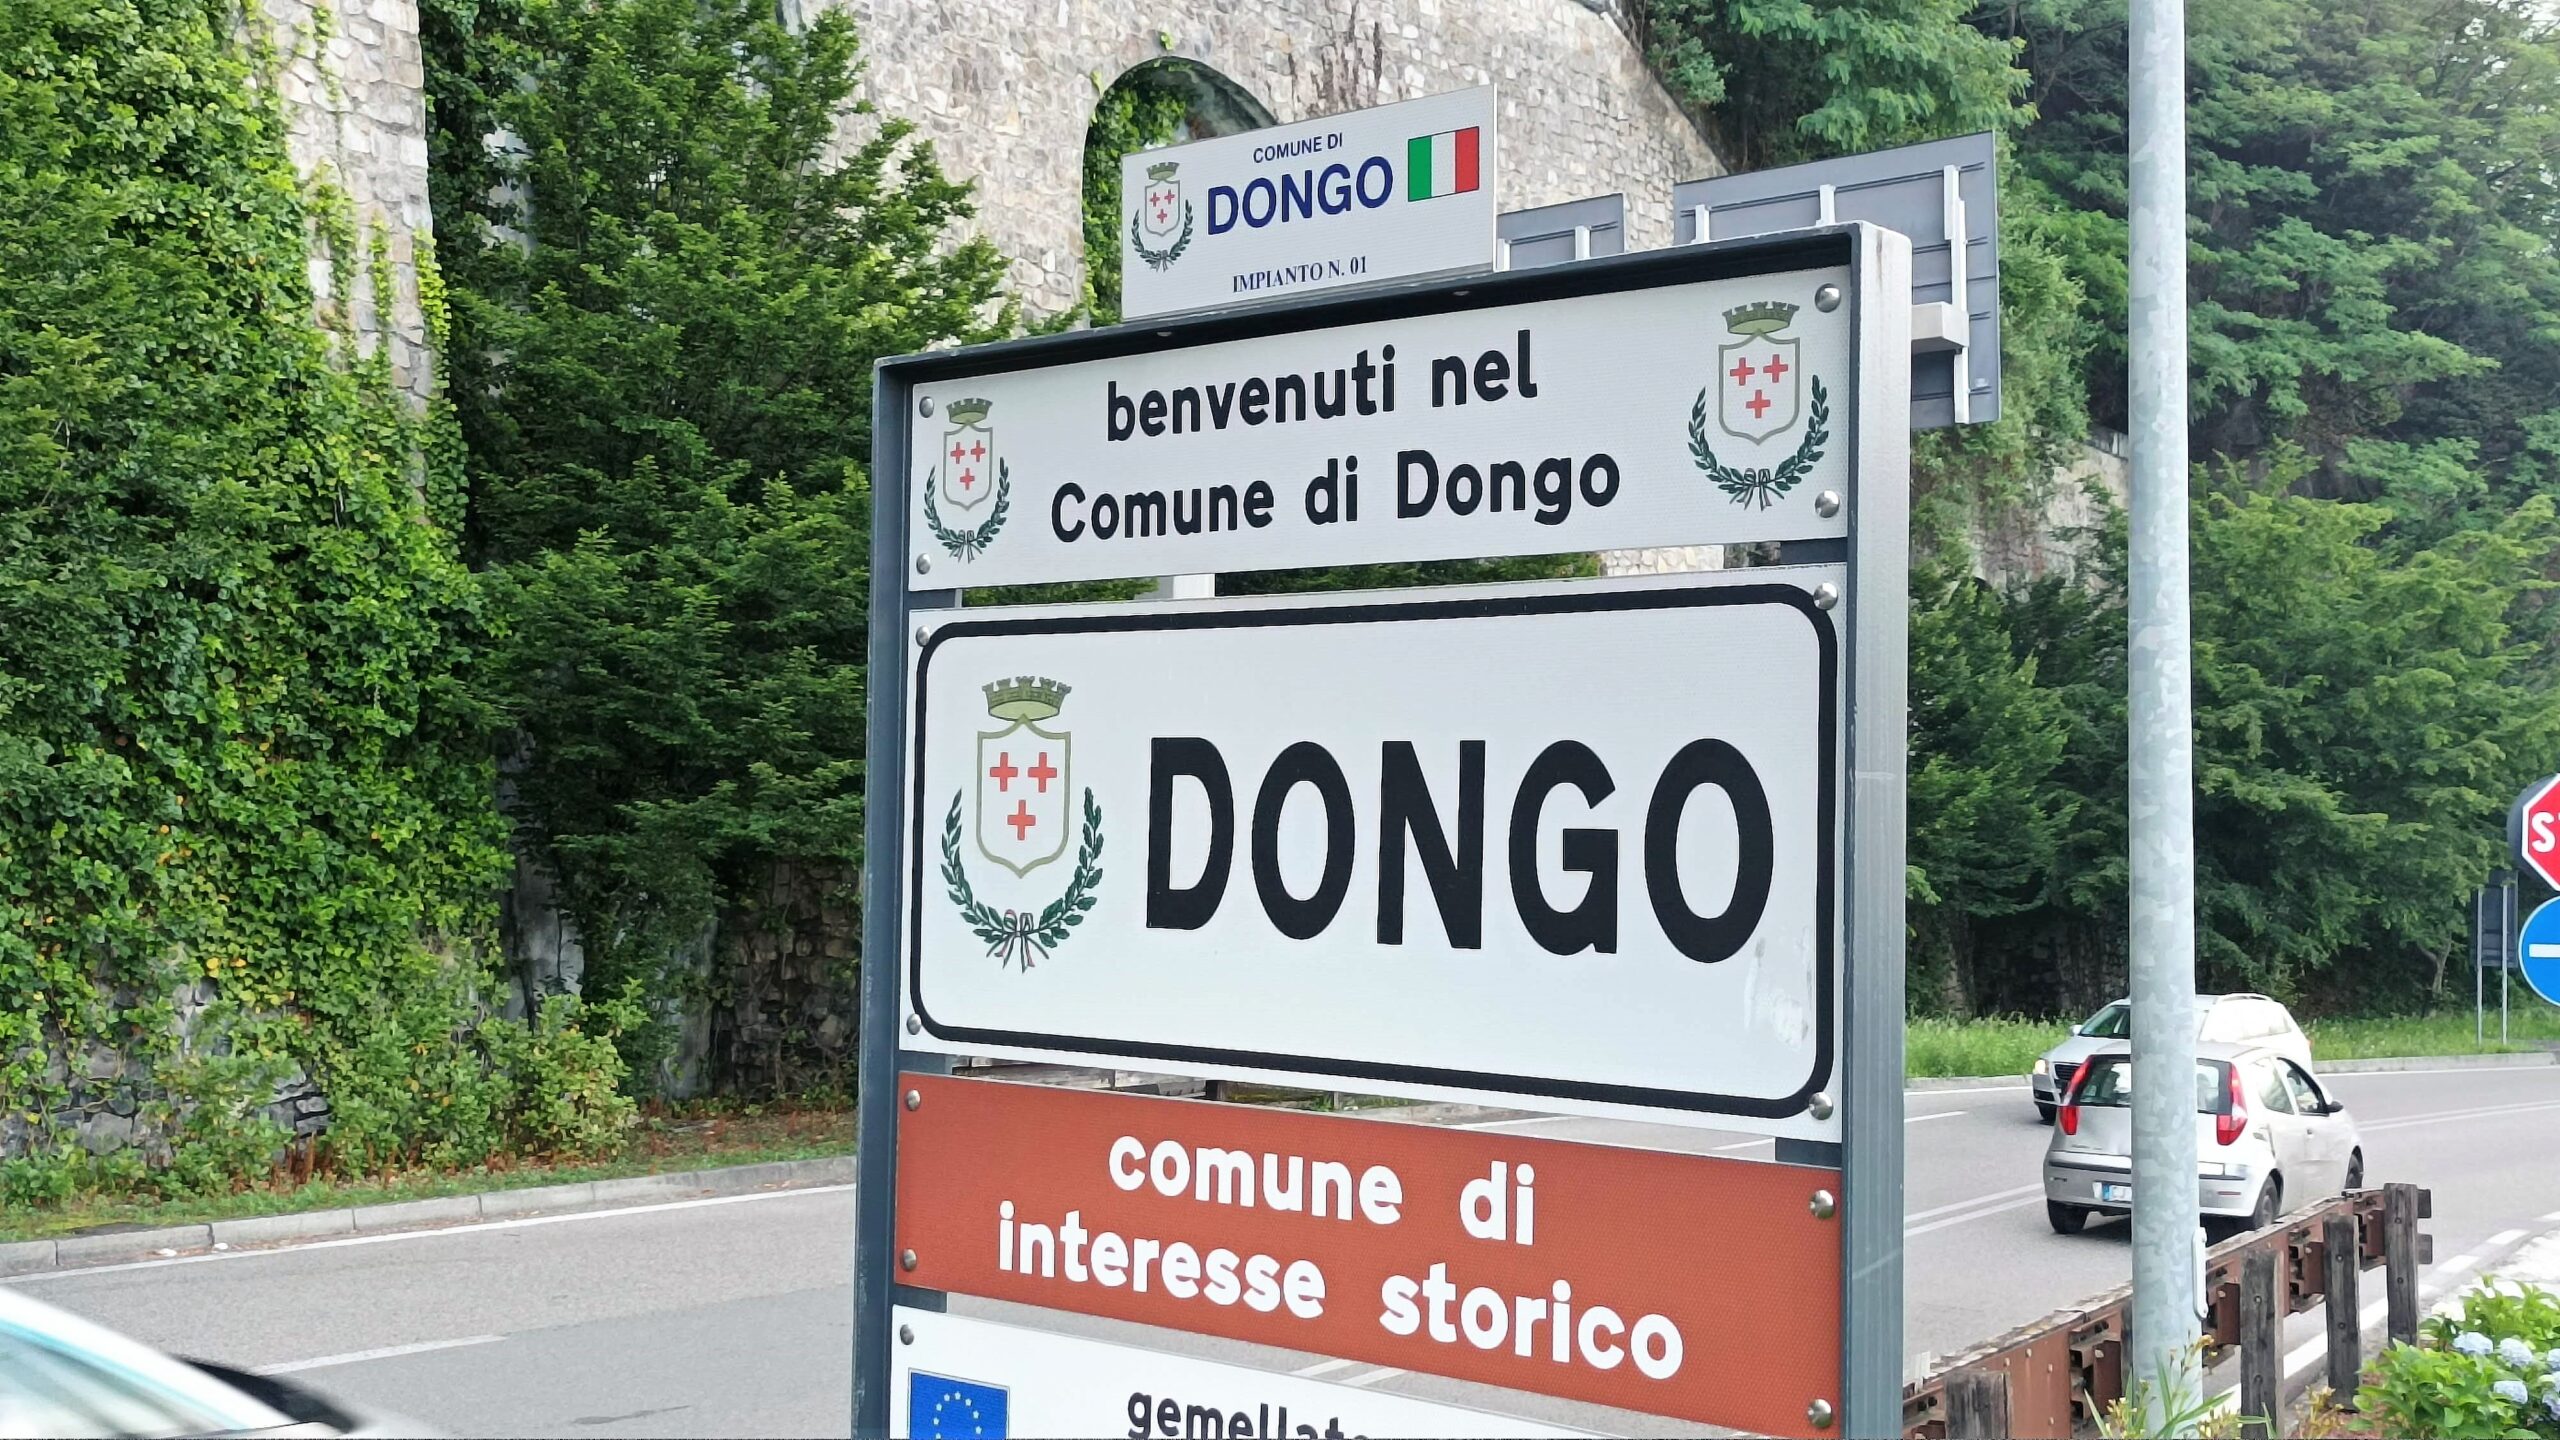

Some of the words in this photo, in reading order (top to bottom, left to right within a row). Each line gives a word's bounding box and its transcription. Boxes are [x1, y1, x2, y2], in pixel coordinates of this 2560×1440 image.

[1253, 136, 1322, 163] COMUNE
[1327, 132, 1343, 149] DI
[1207, 156, 1393, 236] DONGO
[1232, 262, 1323, 293] IMPIANTO
[1328, 259, 1345, 279] N.
[1350, 255, 1367, 274] 01
[1107, 344, 1396, 442] benvenuti
[1431, 329, 1538, 408] nel
[1051, 479, 1274, 543] Comune
[1305, 455, 1359, 525] di
[1397, 449, 1621, 525] Dongo
[1146, 737, 1775, 964] DONGO
[1108, 1135, 1403, 1225] comune
[1459, 1160, 1535, 1246] di
[999, 1200, 1326, 1319] interesse
[1379, 1262, 1684, 1380] storico
[1127, 1391, 1369, 1440] gemell
